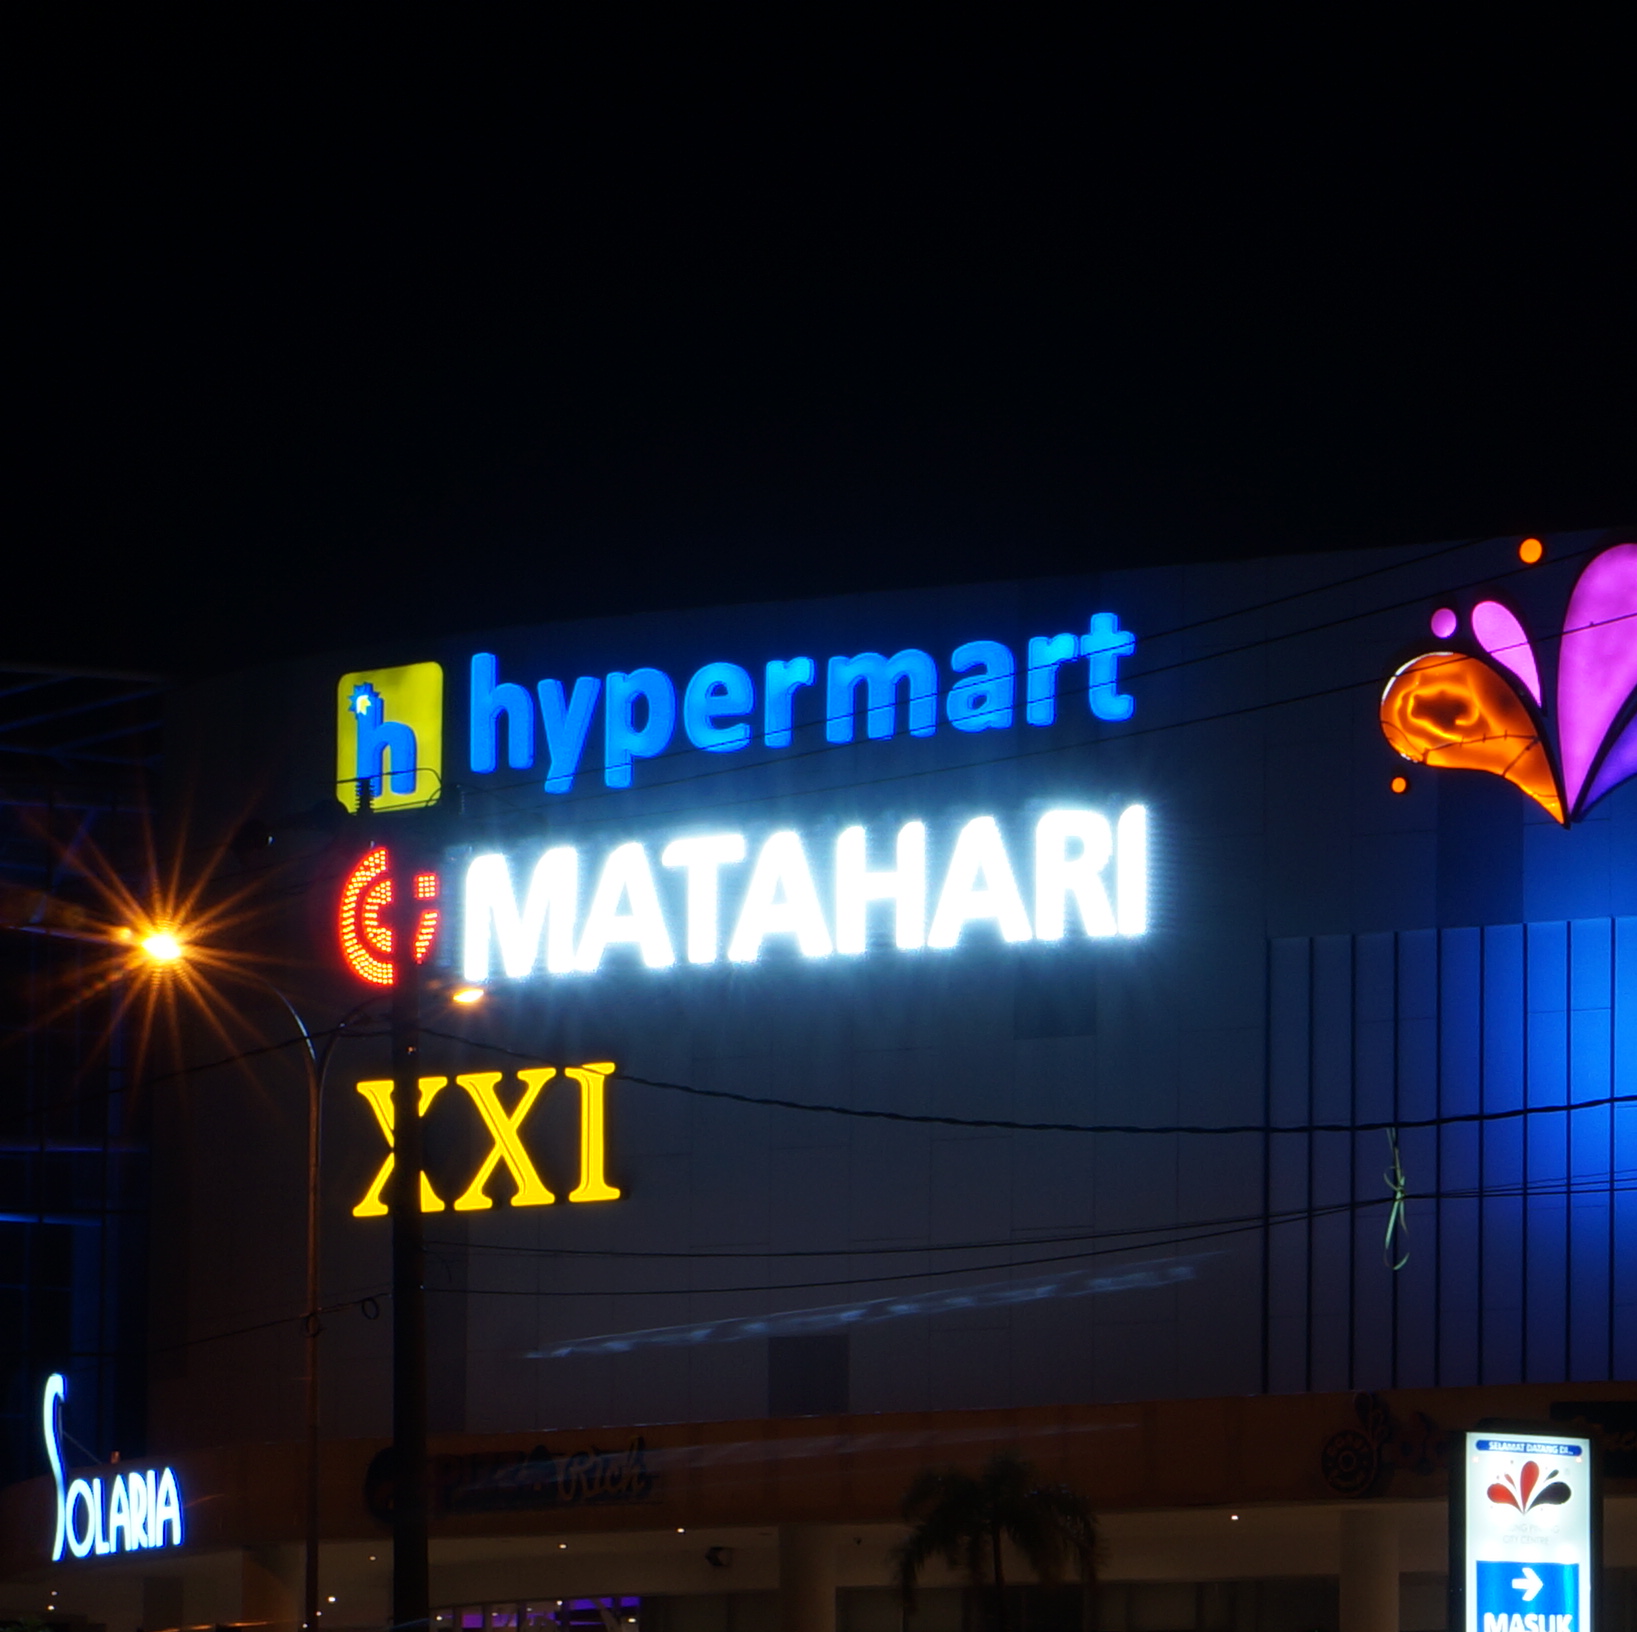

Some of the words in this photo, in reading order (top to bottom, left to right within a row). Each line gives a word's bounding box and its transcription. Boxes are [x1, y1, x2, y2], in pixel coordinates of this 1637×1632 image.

[469, 612, 1136, 794] hypermart
[461, 803, 1150, 985] MATAHARI
[351, 1061, 622, 1219] XXI
[44, 1372, 184, 1562] SOLARIA
[1488, 1441, 1525, 1452] SELAMAT
[1526, 1443, 1559, 1454] DATANG
